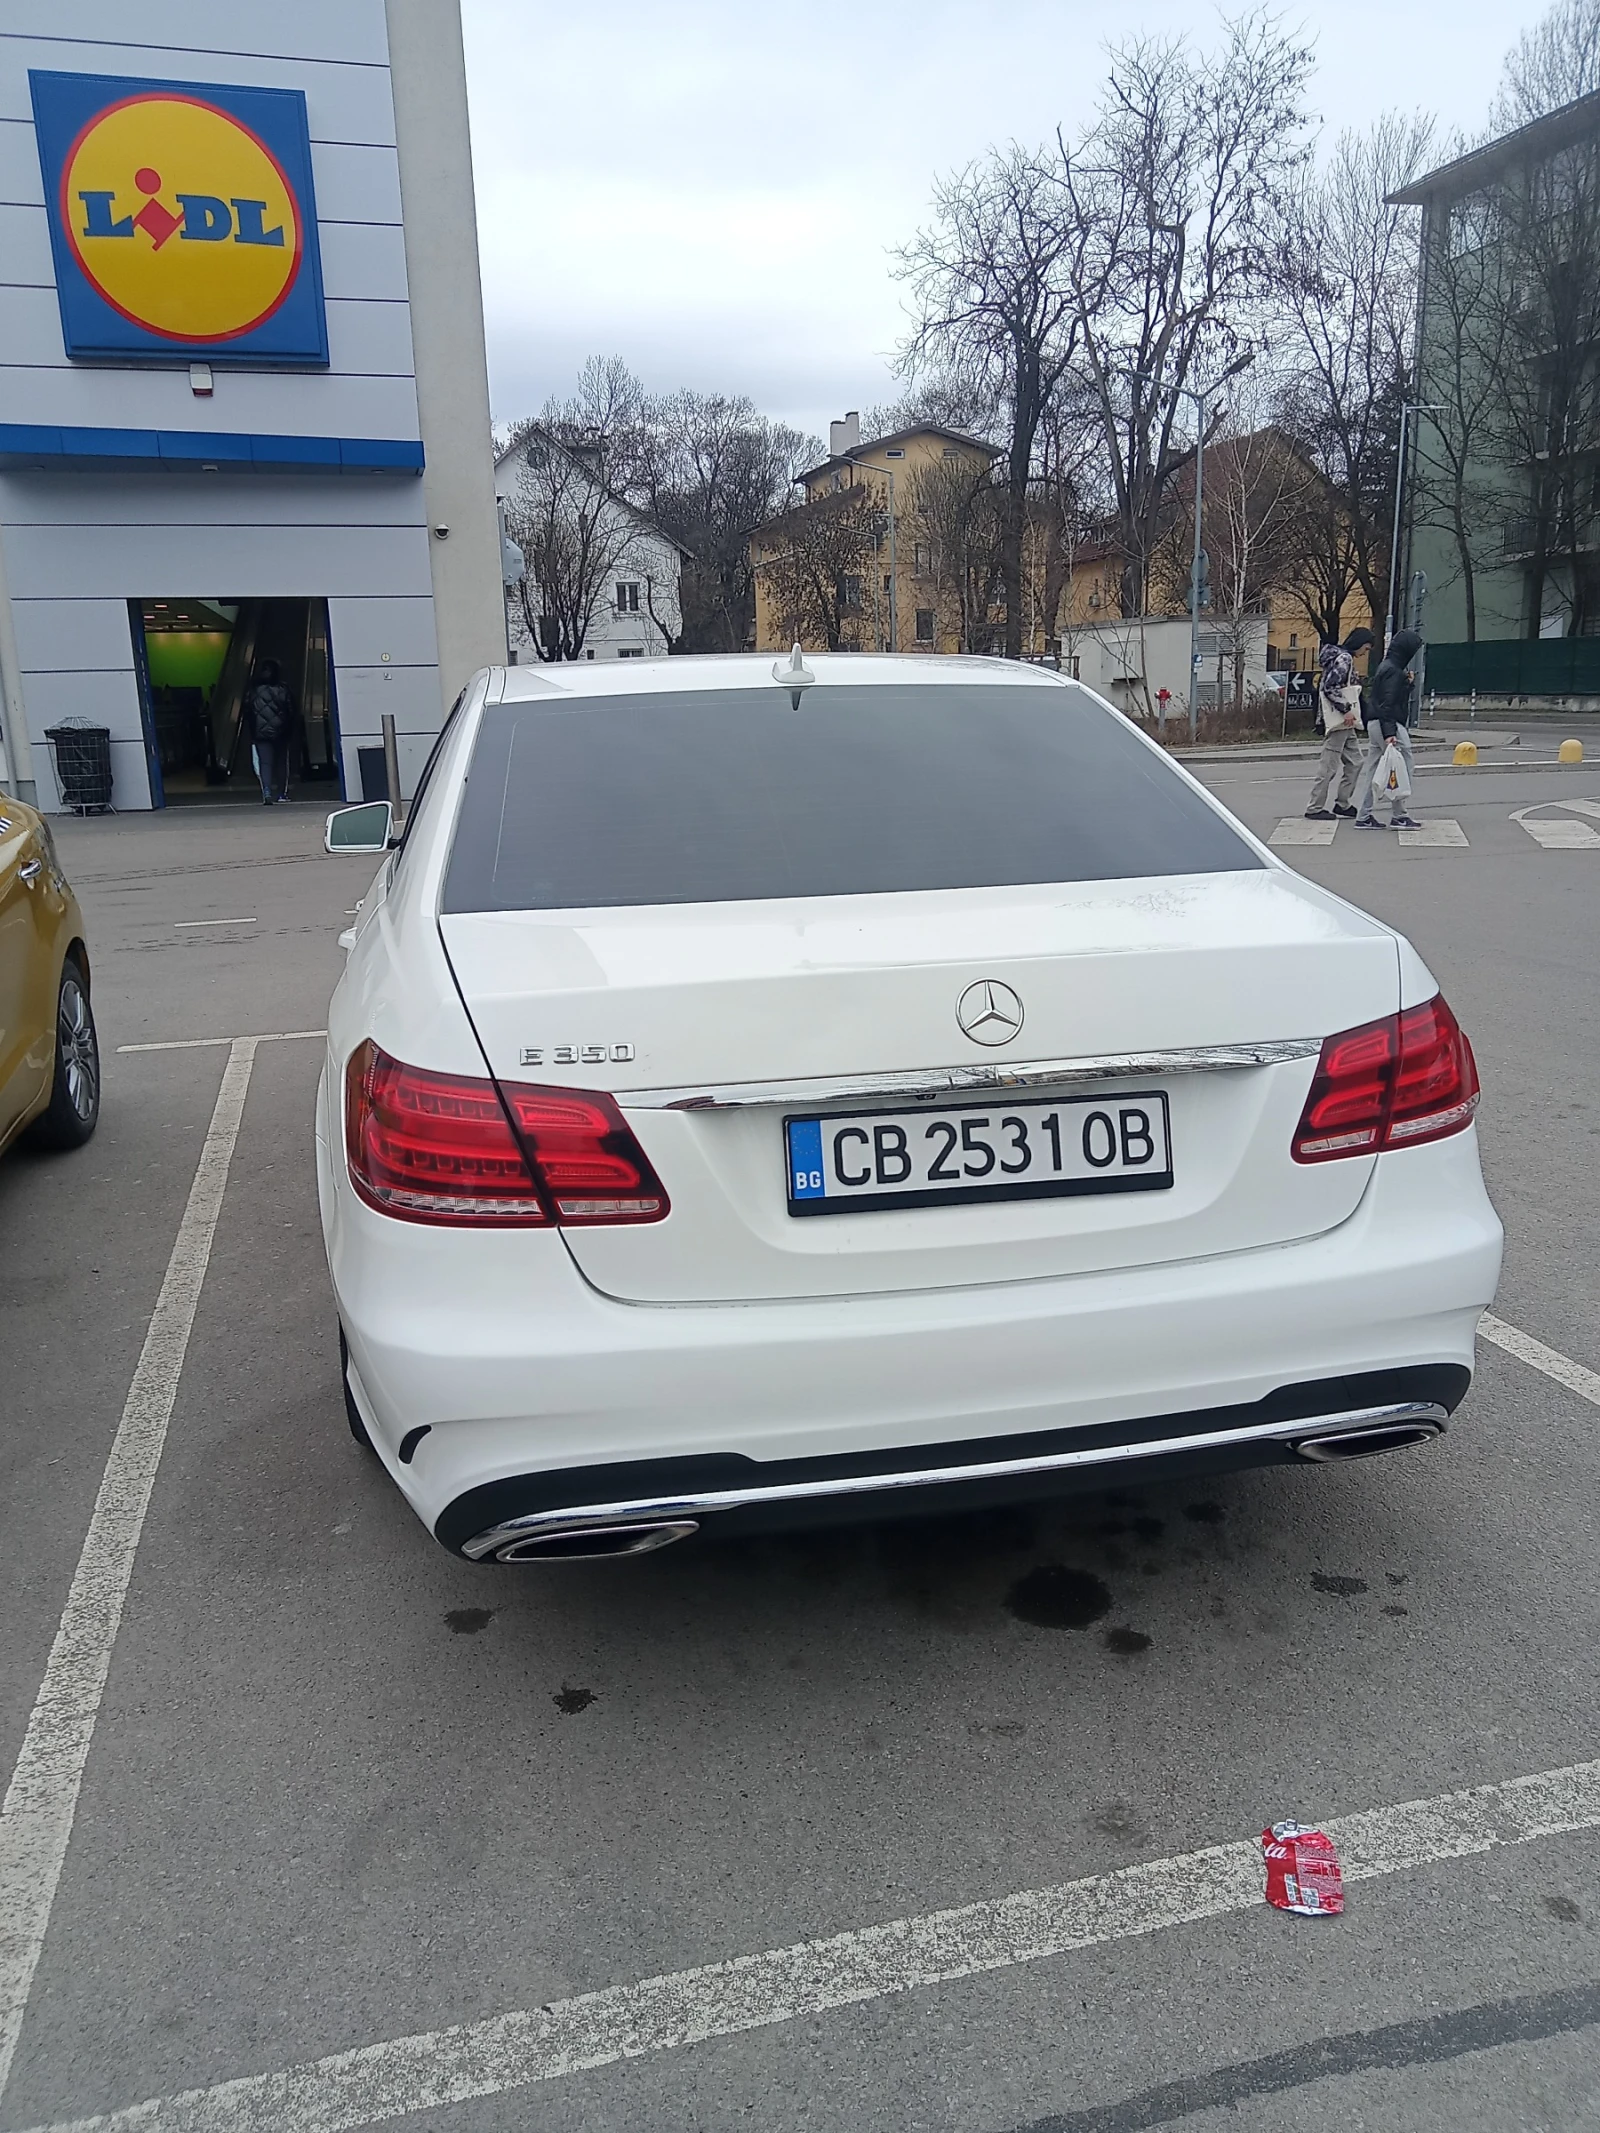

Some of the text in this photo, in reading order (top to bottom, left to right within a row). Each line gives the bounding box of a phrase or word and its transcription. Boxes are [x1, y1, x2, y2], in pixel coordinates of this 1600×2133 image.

[519, 1042, 636, 1066] E 350
[833, 1124, 912, 1186] CB
[924, 1112, 1063, 1181] 2531
[795, 1171, 822, 1190] BG
